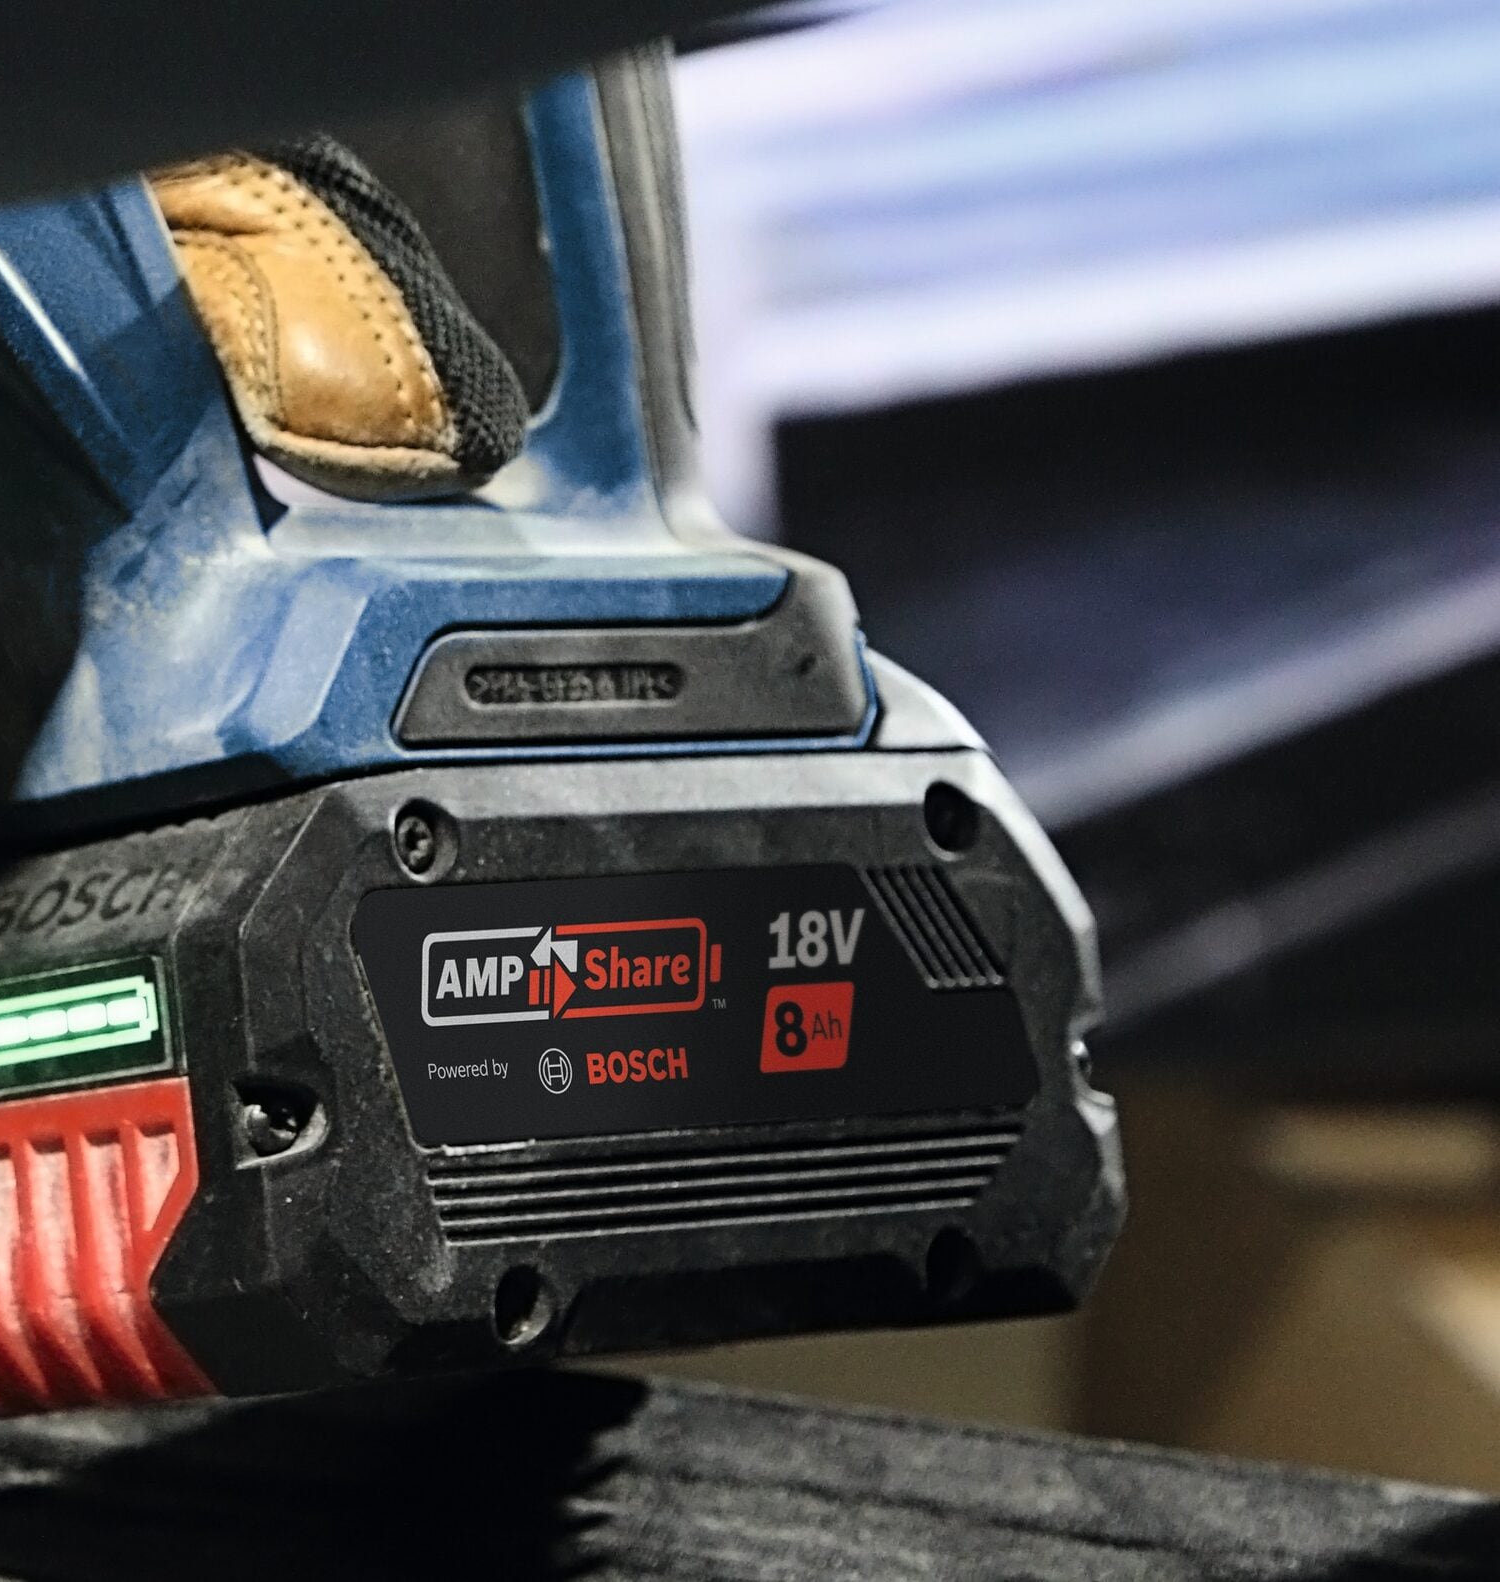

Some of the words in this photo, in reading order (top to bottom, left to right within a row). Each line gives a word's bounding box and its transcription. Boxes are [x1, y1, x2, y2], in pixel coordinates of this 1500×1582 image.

[767, 908, 866, 970] 18V
[435, 955, 524, 1000] AMP
[583, 946, 691, 991] Share
[427, 1059, 489, 1080] Powered
[492, 1058, 509, 1079] by
[586, 1046, 689, 1086] BOSCH
